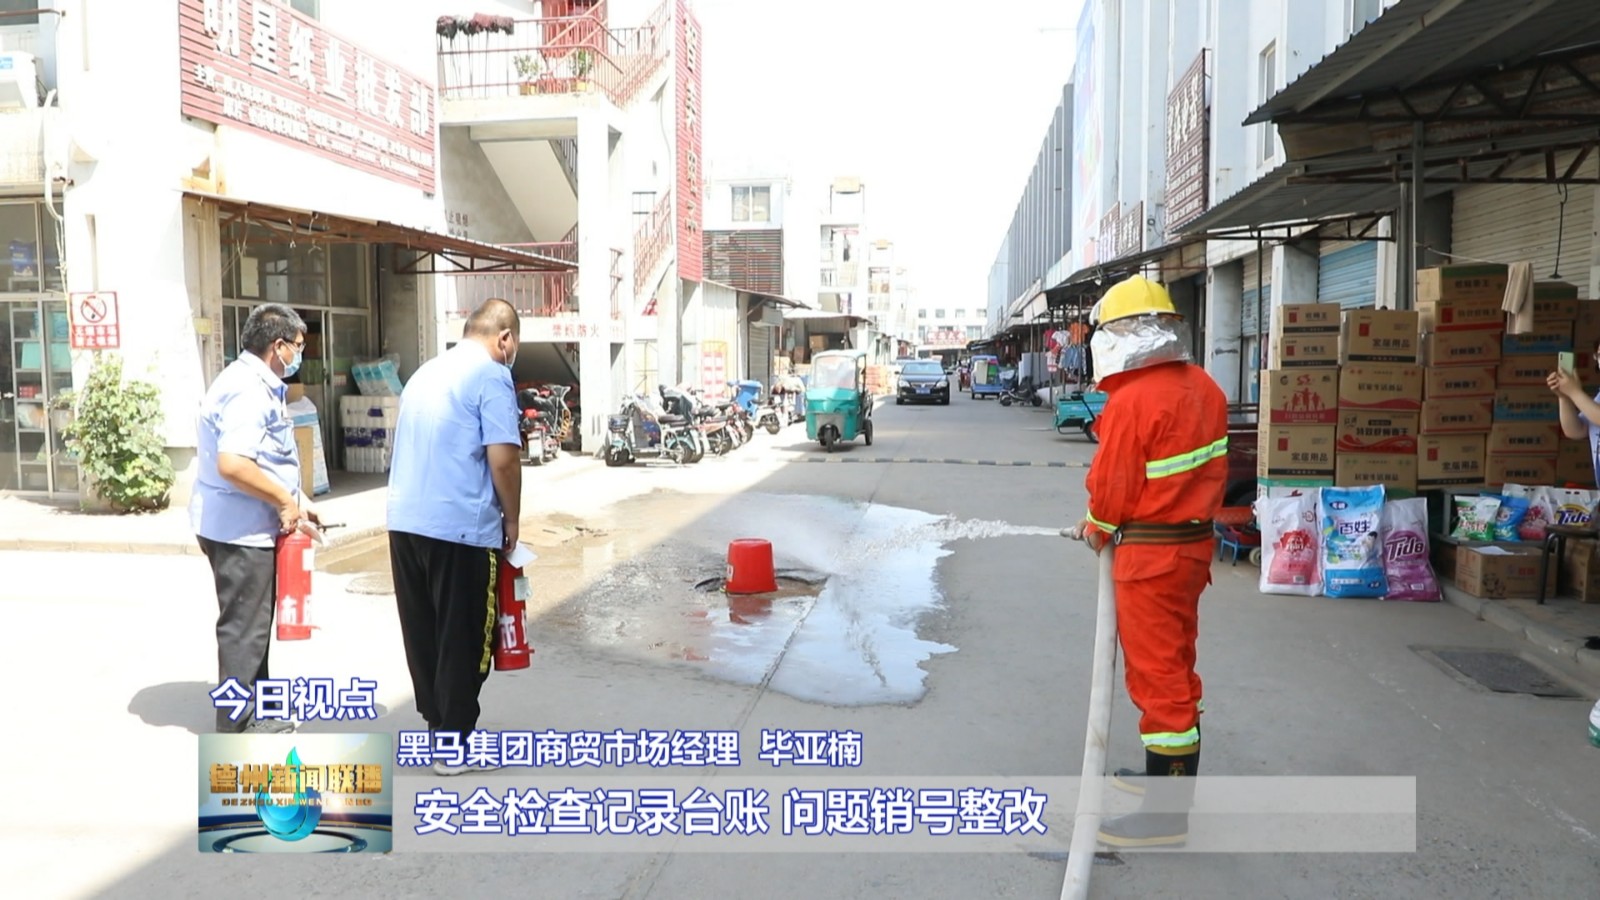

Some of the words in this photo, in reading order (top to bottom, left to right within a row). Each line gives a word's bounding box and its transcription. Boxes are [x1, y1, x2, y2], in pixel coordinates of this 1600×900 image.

[1291, 452, 1328, 462] 家居用品
[1556, 510, 1592, 525] Tide
[1339, 520, 1372, 535] 百姓
[1385, 536, 1425, 561] Tide
